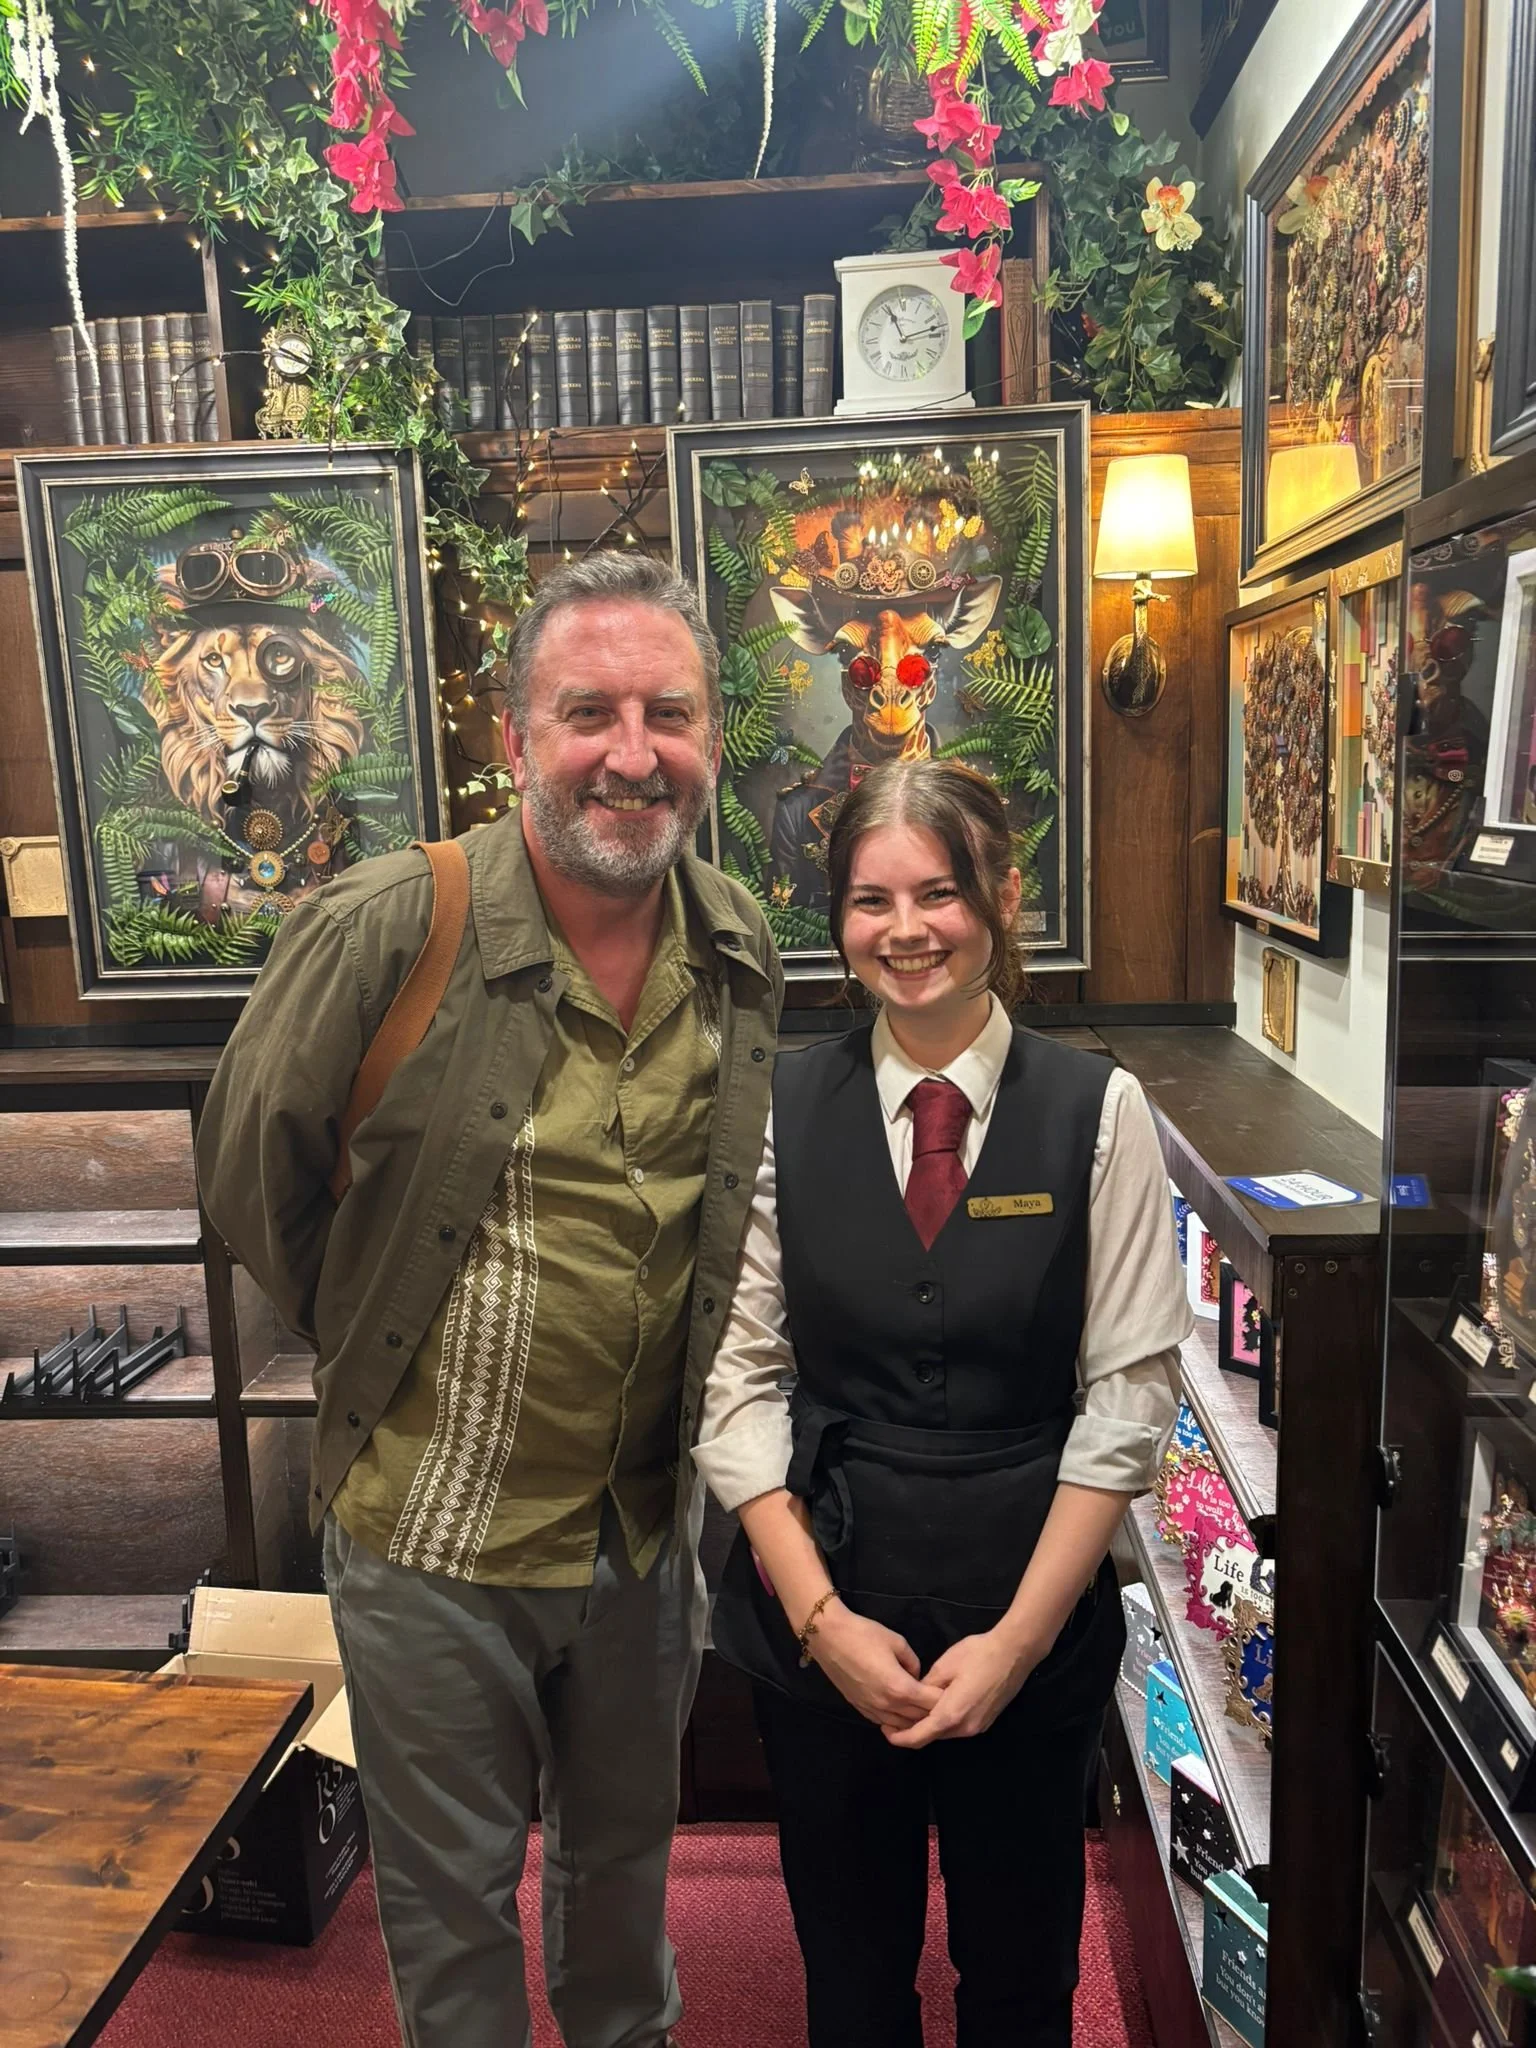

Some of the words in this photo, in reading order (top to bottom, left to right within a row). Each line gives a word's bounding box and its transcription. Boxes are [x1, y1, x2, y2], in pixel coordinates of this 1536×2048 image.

[1102, 20, 1136, 40] YOU
[1013, 1199, 1041, 1209] Maya
[1182, 1428, 1193, 1438] too
[1186, 1470, 1215, 1499] Life
[1195, 1500, 1205, 1510] to
[1205, 1504, 1225, 1517] walk
[1209, 1495, 1218, 1505] is
[1218, 1498, 1232, 1509] too
[1213, 1554, 1245, 1583] Life
[1250, 1590, 1264, 1602] too
[1255, 1643, 1273, 1669] Li
[318, 1803, 336, 1845] O
[1194, 1857, 1208, 1876] You
[1222, 1949, 1256, 1990] Friends
[1215, 1973, 1229, 1993] but
[1230, 1990, 1245, 2009] you
[1220, 1965, 1235, 1987] You
[1236, 1983, 1256, 2007] don't
